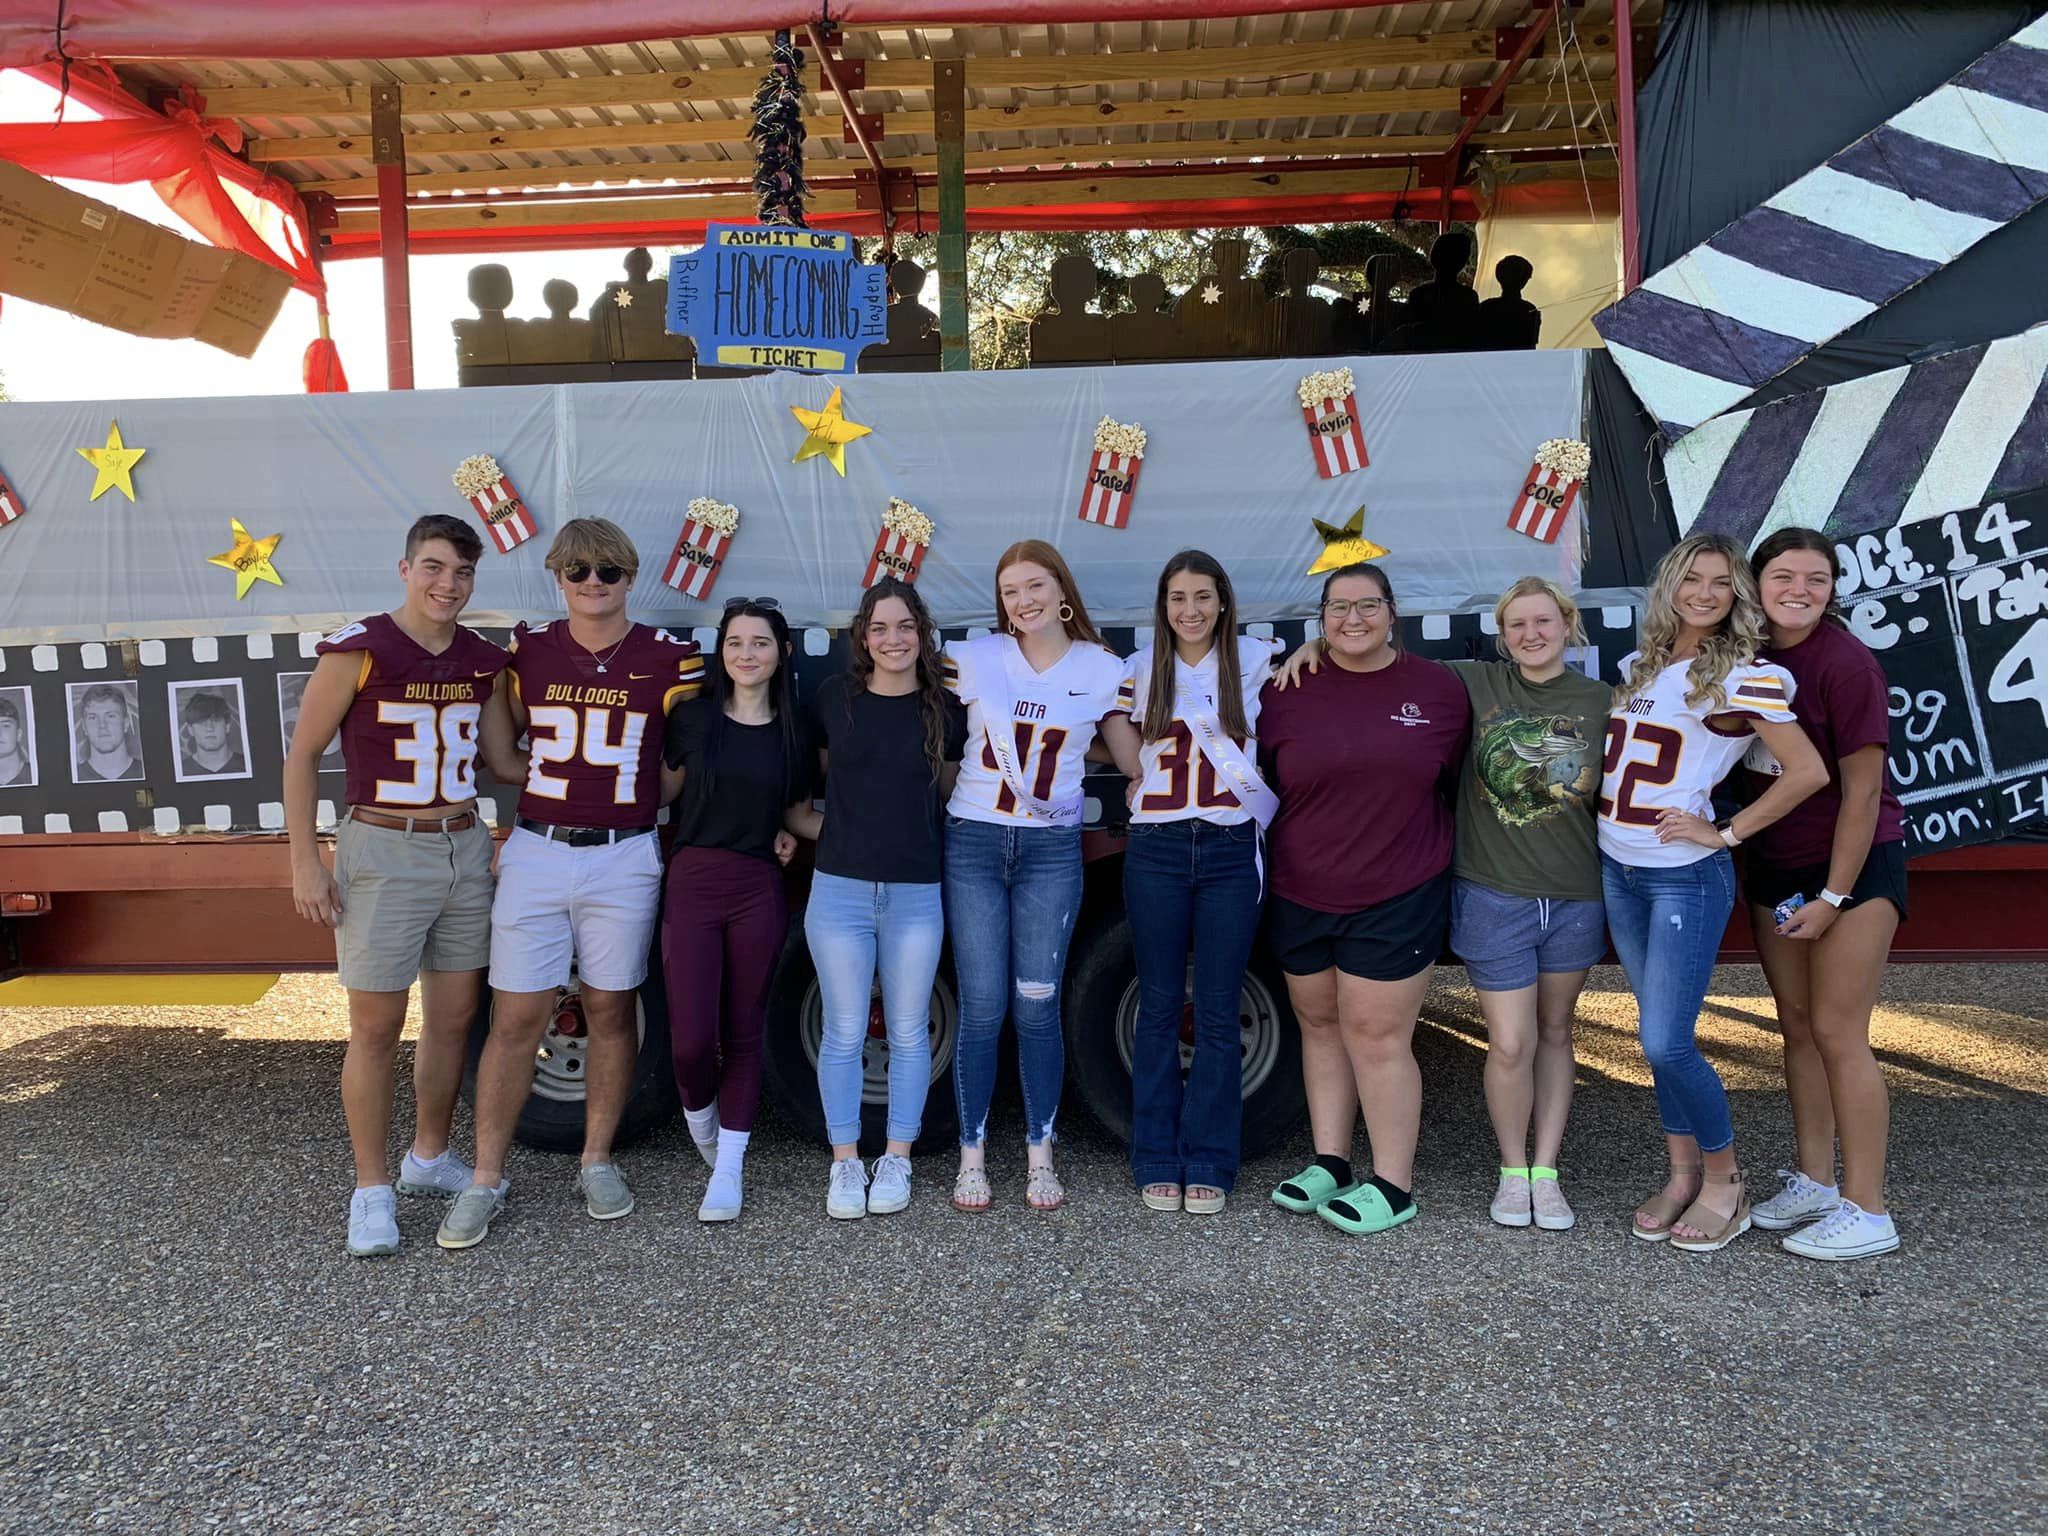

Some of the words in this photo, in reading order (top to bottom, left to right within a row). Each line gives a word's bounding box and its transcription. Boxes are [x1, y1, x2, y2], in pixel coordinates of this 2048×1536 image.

[726, 231, 798, 246] ADMIT
[676, 258, 699, 325] Ruffner
[713, 251, 860, 340] HOMECOMING
[861, 272, 884, 337] Hayden
[750, 347, 817, 369] TICKET
[1307, 414, 1354, 437] Baylin
[1090, 468, 1135, 495] Jared
[1525, 482, 1564, 509] Cole
[1942, 502, 2032, 571] 14
[678, 541, 723, 570] Sayer
[876, 550, 916, 575] Carah
[404, 683, 474, 700] BULLDOGS
[545, 684, 629, 706] BULLDOGS
[1014, 700, 1047, 719] IOTA
[374, 700, 482, 806] 38
[525, 705, 648, 804] 24
